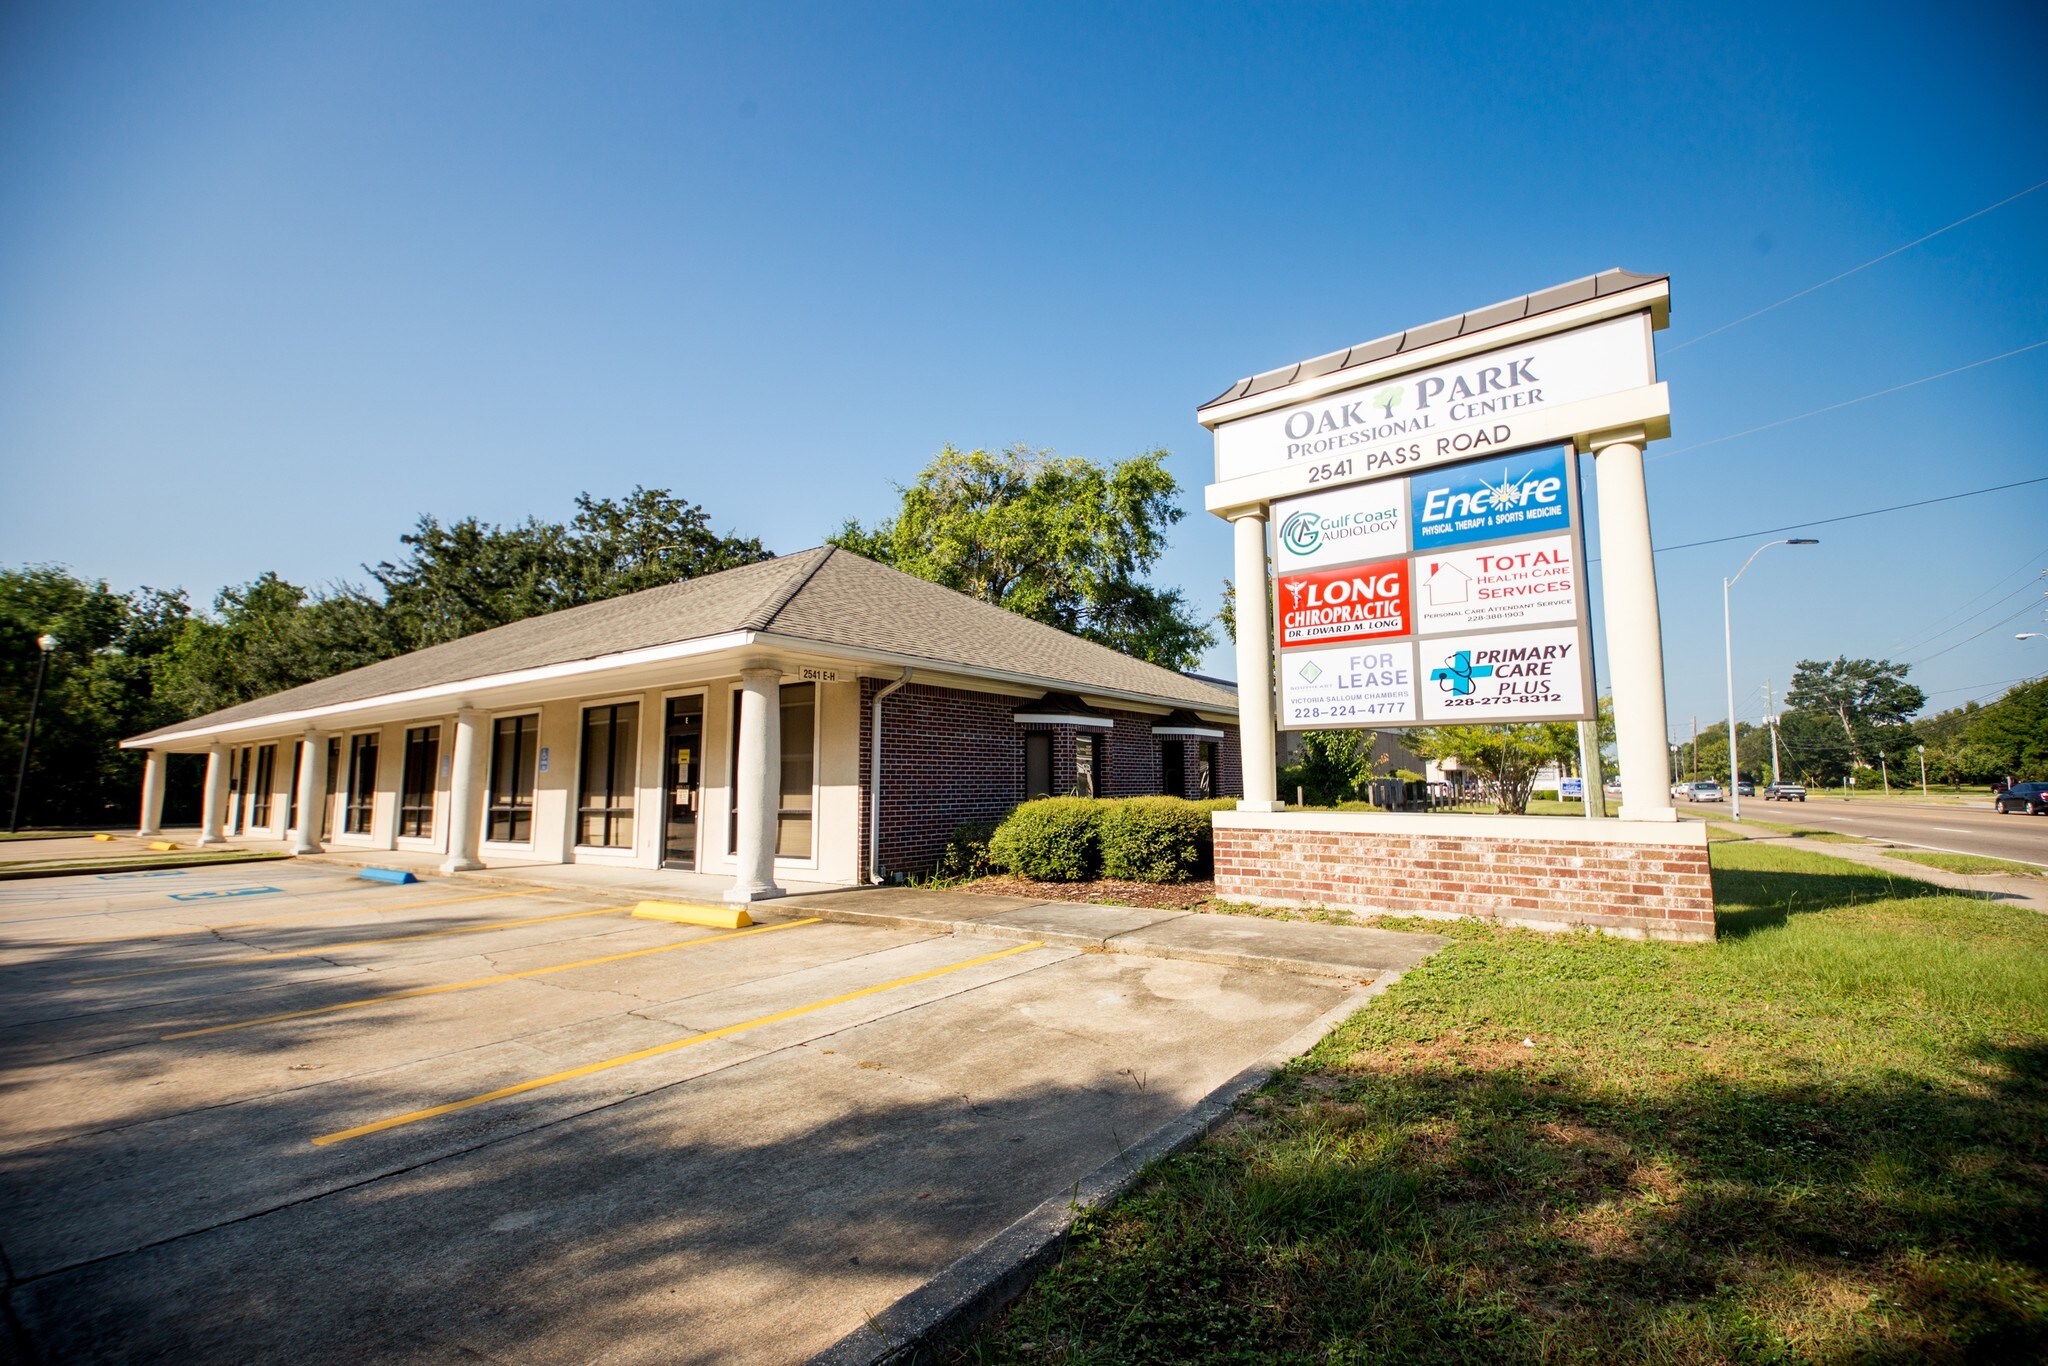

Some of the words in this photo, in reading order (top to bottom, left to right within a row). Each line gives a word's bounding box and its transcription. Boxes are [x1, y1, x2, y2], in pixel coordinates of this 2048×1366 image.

[1284, 401, 1366, 440] OAK
[1415, 356, 1539, 410] PARK
[1287, 414, 1435, 460] PROFESSIONAL
[1450, 388, 1544, 421] CENTER
[1309, 459, 1353, 484] 2541
[1367, 444, 1421, 471] PASS
[1437, 425, 1511, 456] ROAD
[1320, 514, 1351, 530] Gulf
[1354, 507, 1398, 524] Coast
[1422, 523, 1453, 536] PHYSICAL
[1455, 517, 1485, 531] THERAPY
[1487, 516, 1493, 526] &
[1495, 511, 1524, 525] SPORTS
[1526, 505, 1562, 520] MEDICINE
[1321, 519, 1398, 542] AUDIOLOGY
[1476, 549, 1569, 573] TOTAL
[1477, 572, 1528, 585] HEALTH
[1532, 566, 1570, 578] CARE
[1306, 573, 1400, 607] LONG
[1478, 580, 1571, 600] SERVICES
[1284, 599, 1401, 628] CHIROPRACTIC
[1423, 611, 1462, 619] PERSONAL
[1488, 603, 1535, 613] ATTENDANT
[1537, 599, 1573, 608] SERVICE
[1288, 630, 1304, 638] DR.
[1307, 624, 1351, 636] EDWARD
[1353, 623, 1365, 631] M.
[1369, 619, 1398, 629] LONG
[1350, 653, 1393, 671] FOR
[1475, 644, 1573, 665] PRIMARY
[803, 669, 821, 680] 2541
[823, 671, 835, 681] E-H
[1338, 669, 1408, 689] LEASE
[1495, 661, 1553, 679] CARE
[1326, 693, 1362, 702] SALLOUM
[1364, 691, 1409, 700] CHAMBERS
[1498, 680, 1551, 695] PLUS
[1295, 702, 1405, 719] 228-224-4777
[1444, 694, 1562, 707] 228-273-8312
